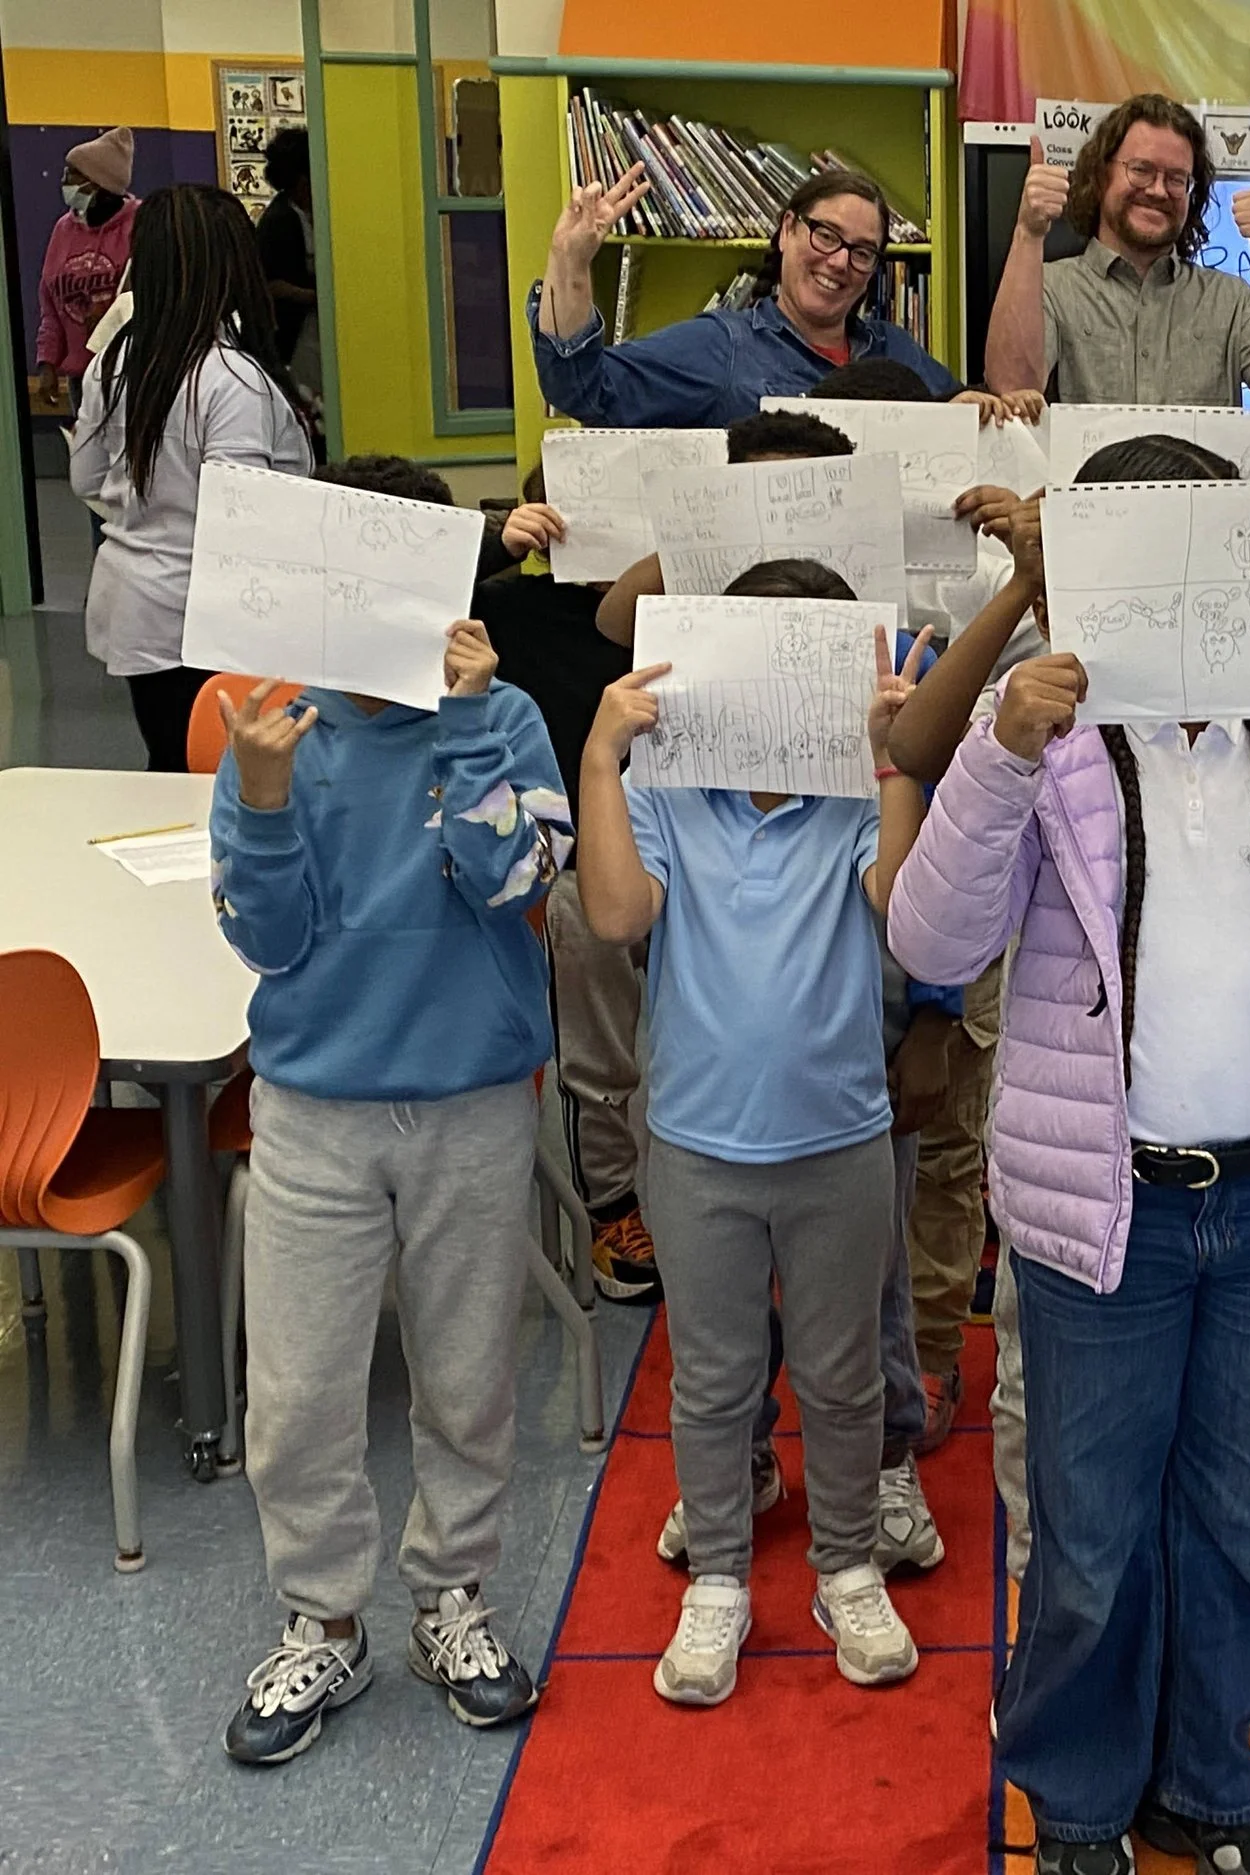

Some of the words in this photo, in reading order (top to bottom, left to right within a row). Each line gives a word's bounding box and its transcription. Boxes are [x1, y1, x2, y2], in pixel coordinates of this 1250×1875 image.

[1043, 108, 1092, 135] LOOK
[1046, 143, 1073, 154] Class
[1046, 157, 1075, 167] Conve
